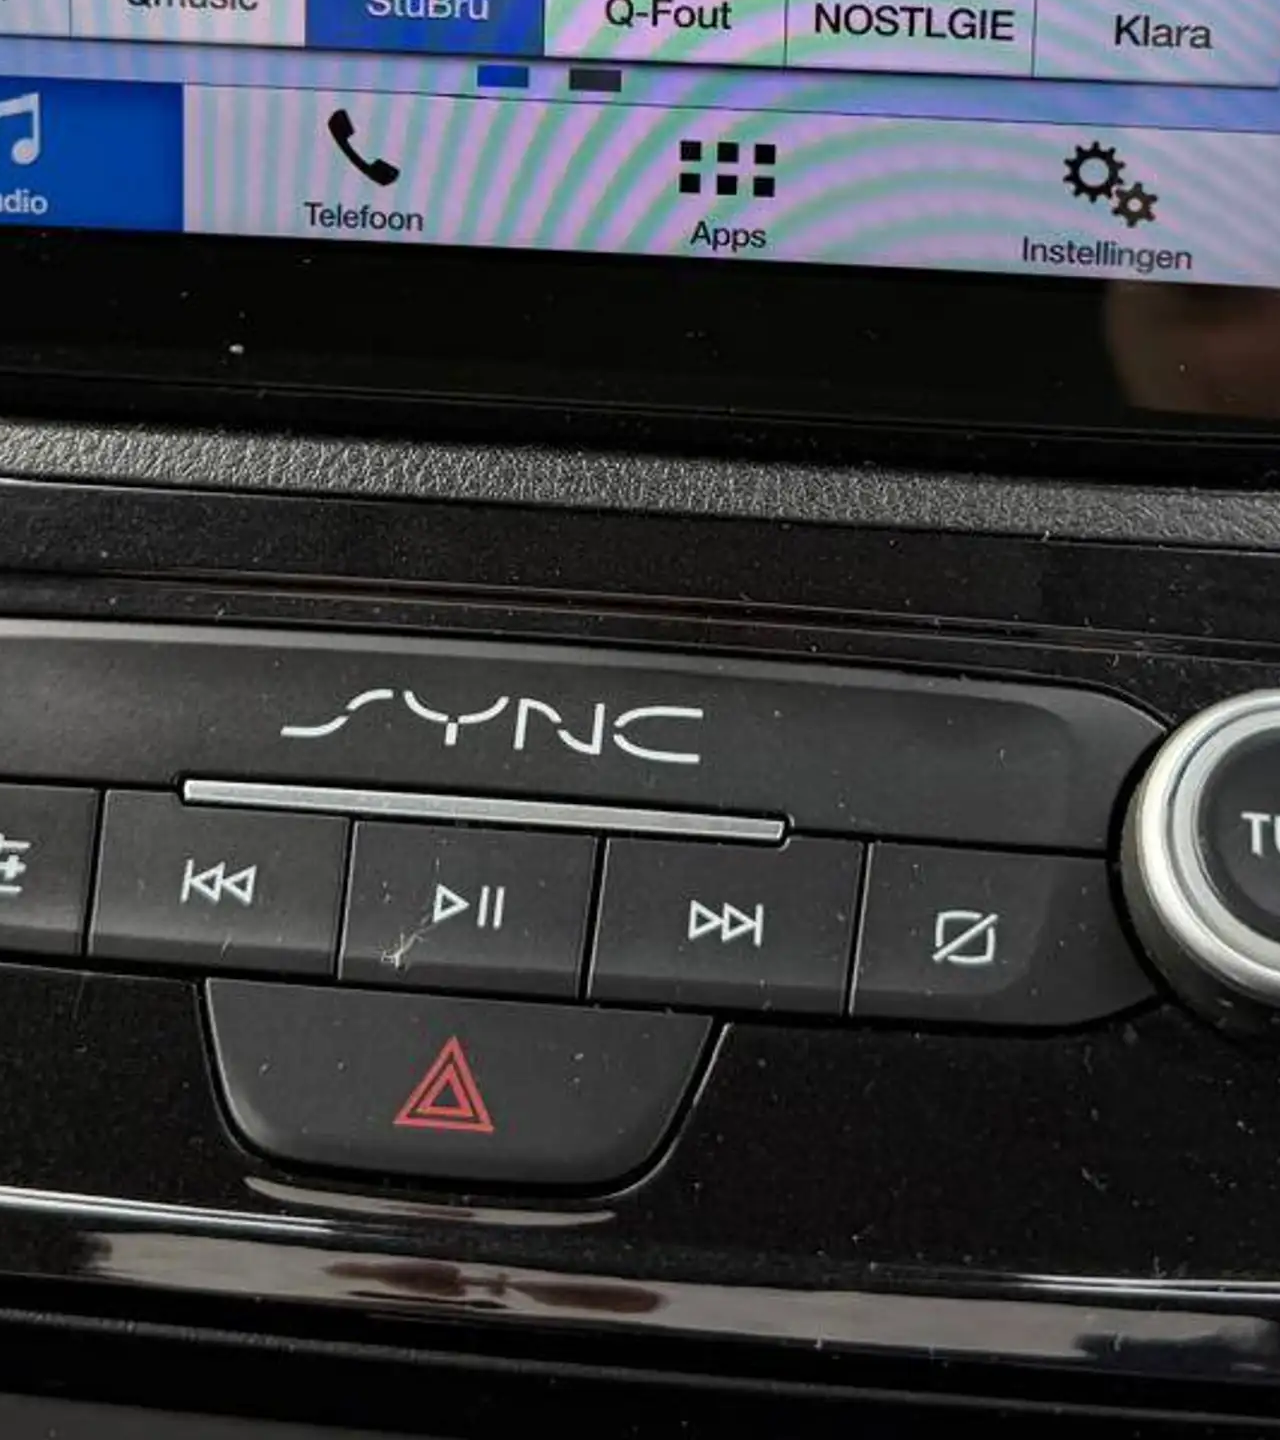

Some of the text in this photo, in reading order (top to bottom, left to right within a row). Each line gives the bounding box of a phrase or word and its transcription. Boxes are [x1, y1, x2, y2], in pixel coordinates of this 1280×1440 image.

[813, 4, 1015, 42] NOSTLGIE
[1114, 14, 1212, 51] Klara
[304, 202, 424, 232] Telefoon
[689, 221, 767, 252] Apps
[1022, 236, 1192, 273] Instellingen
[280, 688, 704, 766] SYNC
